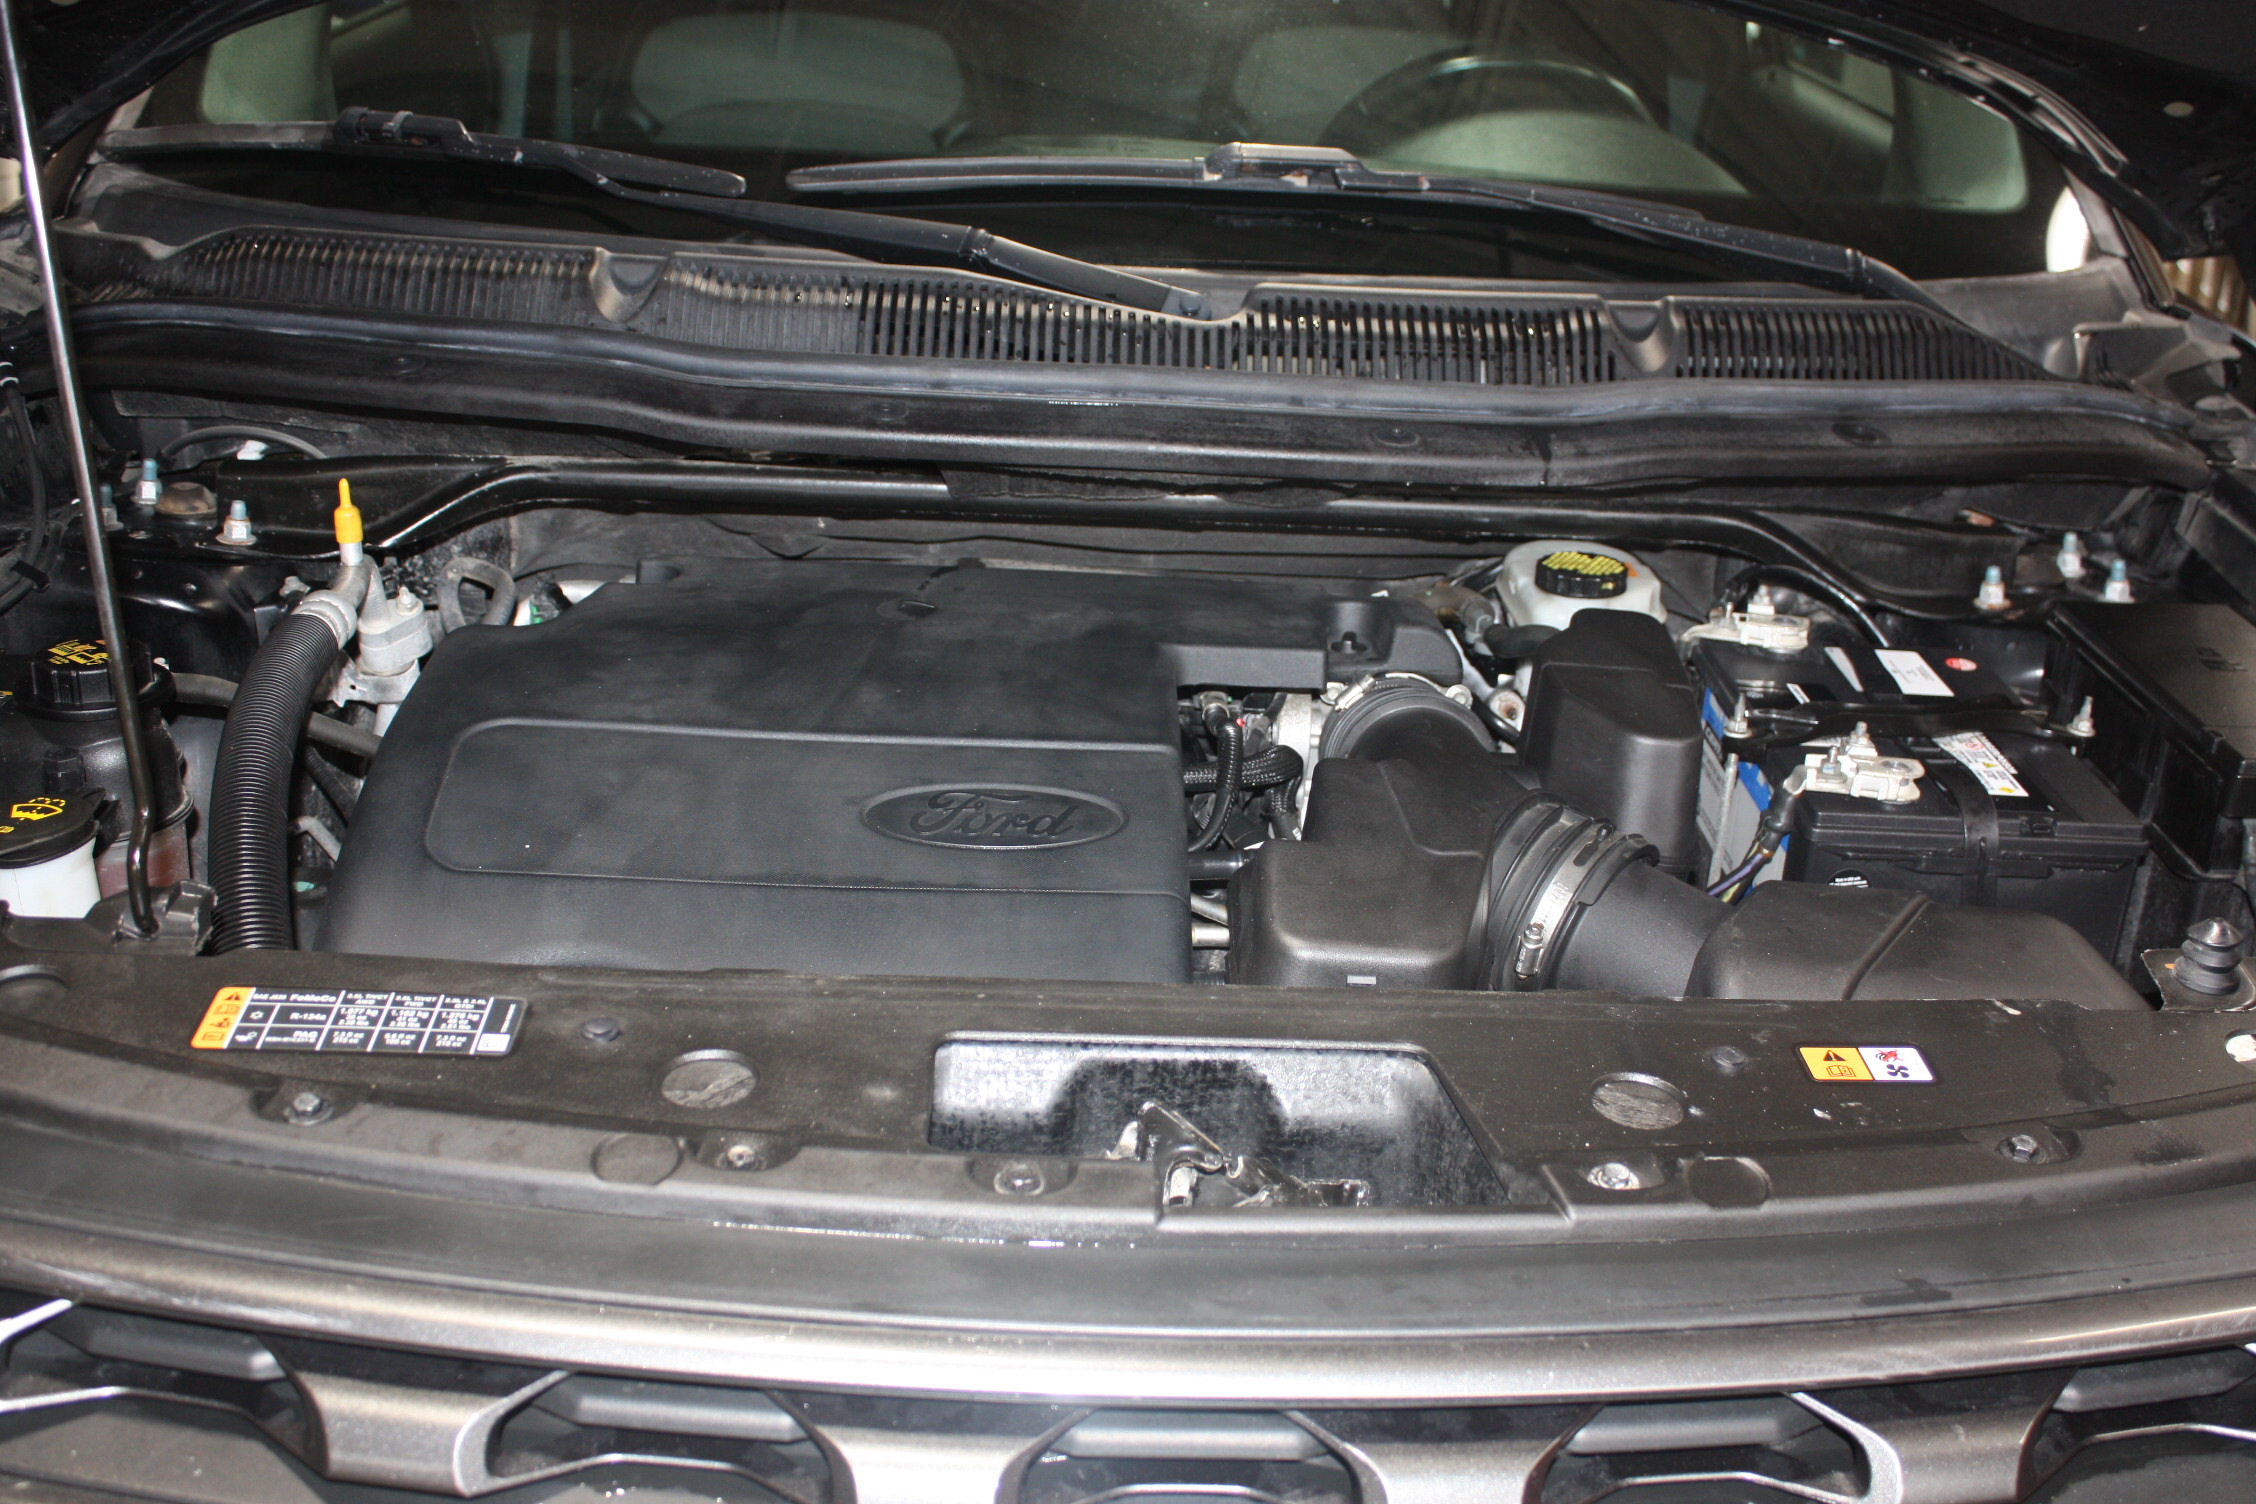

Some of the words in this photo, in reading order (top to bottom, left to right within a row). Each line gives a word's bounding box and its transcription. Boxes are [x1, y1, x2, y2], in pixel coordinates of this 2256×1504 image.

[909, 791, 1080, 838] Ford
[290, 993, 336, 1002] FoMoCo
[290, 1012, 327, 1020] R-134a
[293, 1031, 318, 1039] PAG
